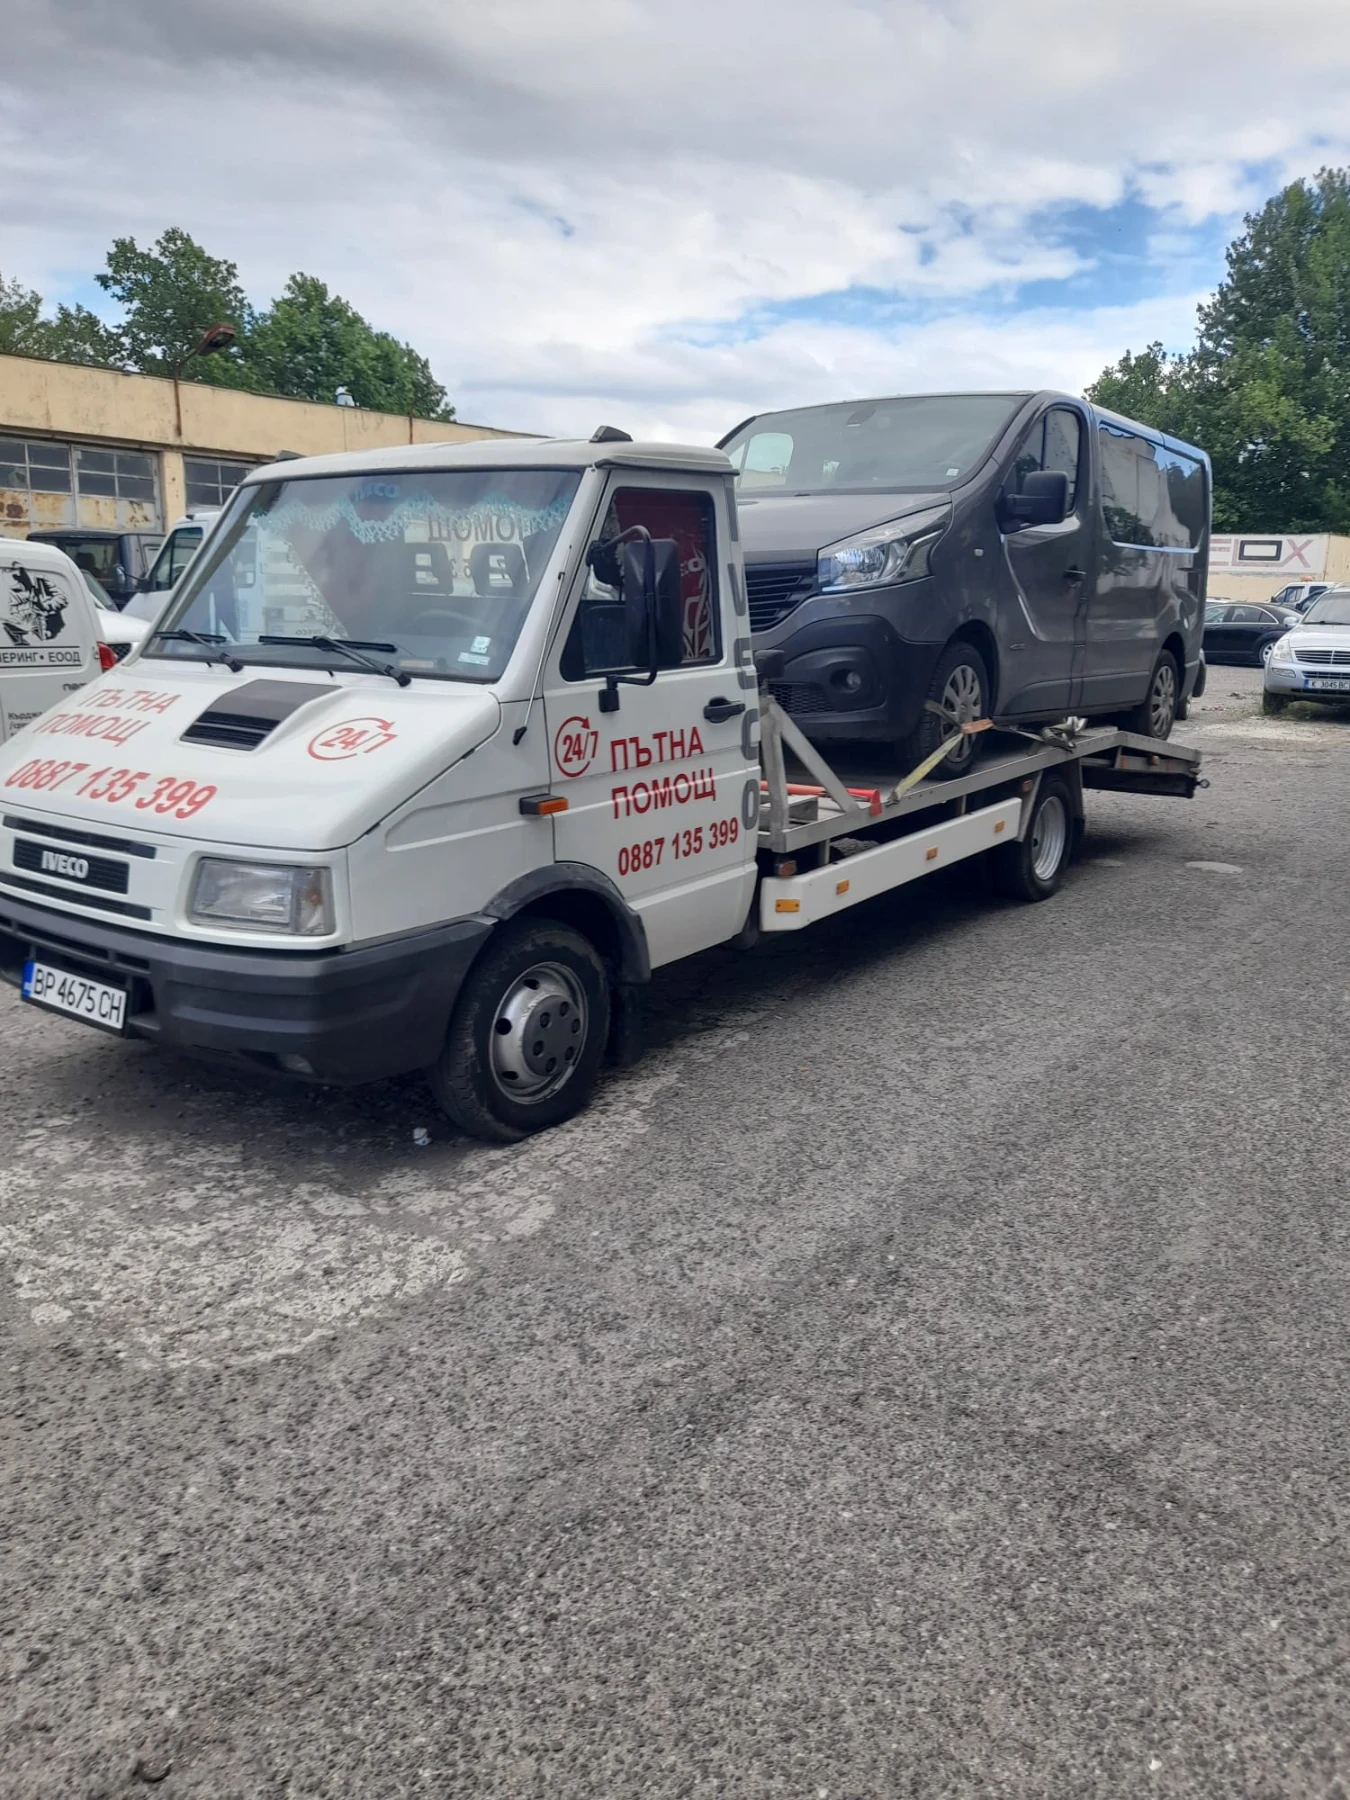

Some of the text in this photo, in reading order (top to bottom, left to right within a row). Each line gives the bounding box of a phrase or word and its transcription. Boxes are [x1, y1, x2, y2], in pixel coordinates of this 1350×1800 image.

[0, 651, 81, 664] ЕРИНГ ЕООД
[78, 688, 182, 714] ПЪТНА
[32, 713, 151, 748] ПОМОЩ
[319, 726, 399, 754] 24/7
[563, 730, 599, 764] 24/7
[610, 726, 705, 772] ПЪТНА
[4, 758, 218, 820] 0887 135 399
[611, 767, 716, 820] ПОМОЩ
[618, 817, 739, 876] 0887 135 399
[41, 850, 89, 879] IVECO
[34, 968, 122, 1023] BP 4675 CH
